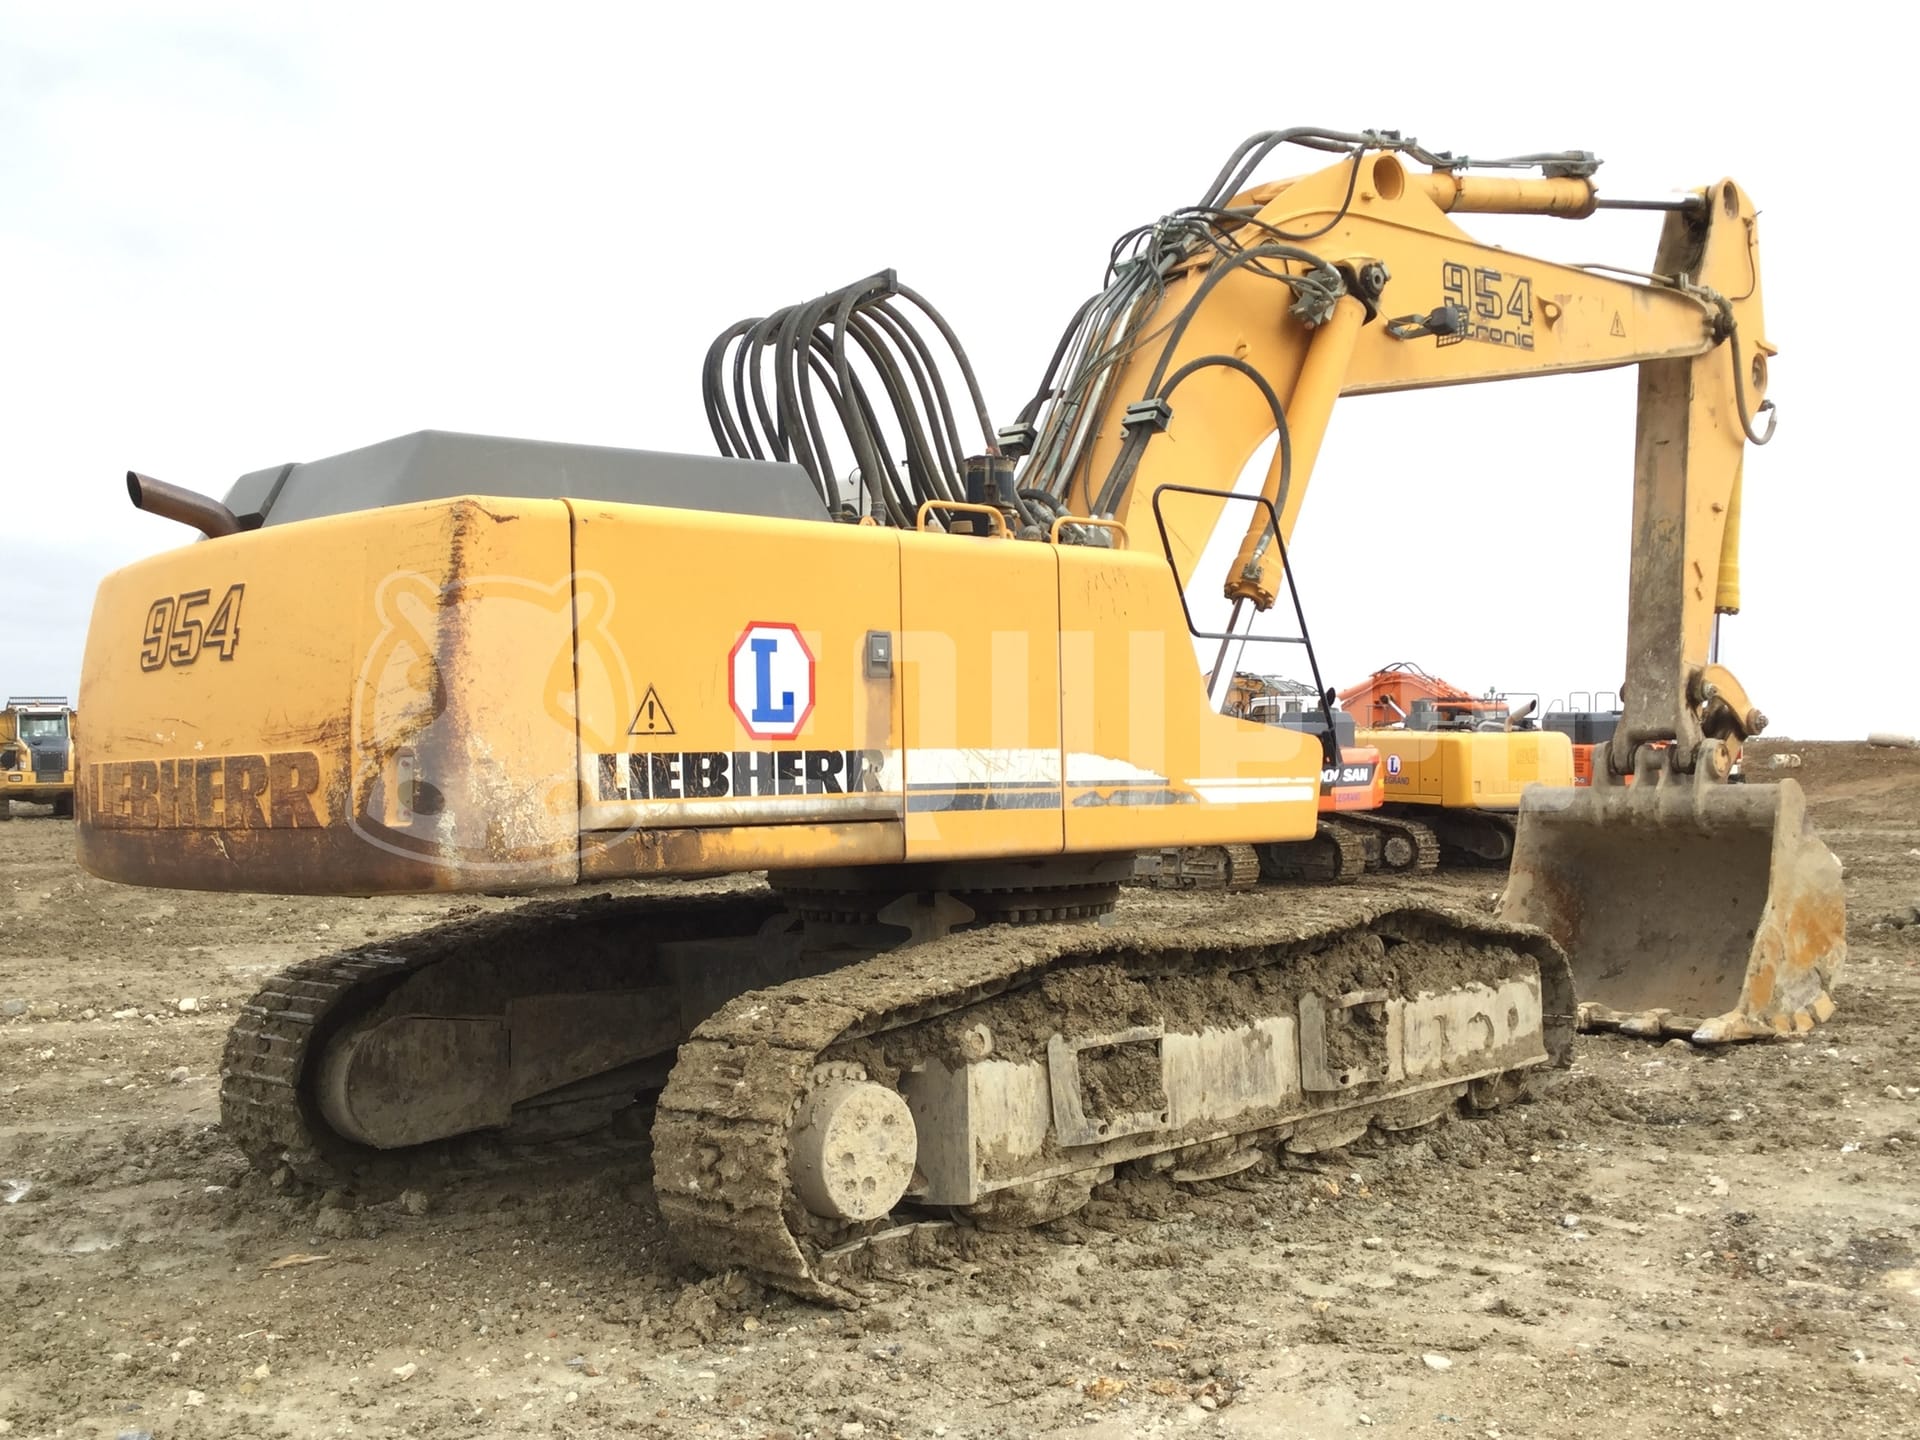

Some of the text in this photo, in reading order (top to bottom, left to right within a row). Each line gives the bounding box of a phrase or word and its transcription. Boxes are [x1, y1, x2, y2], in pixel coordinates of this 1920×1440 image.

[1443, 261, 1532, 327] 954
[1465, 320, 1534, 349] tronic
[141, 583, 246, 672] 954
[750, 638, 795, 723] L
[89, 750, 327, 830] LIEBHERR
[598, 748, 886, 801] LIEBHERR
